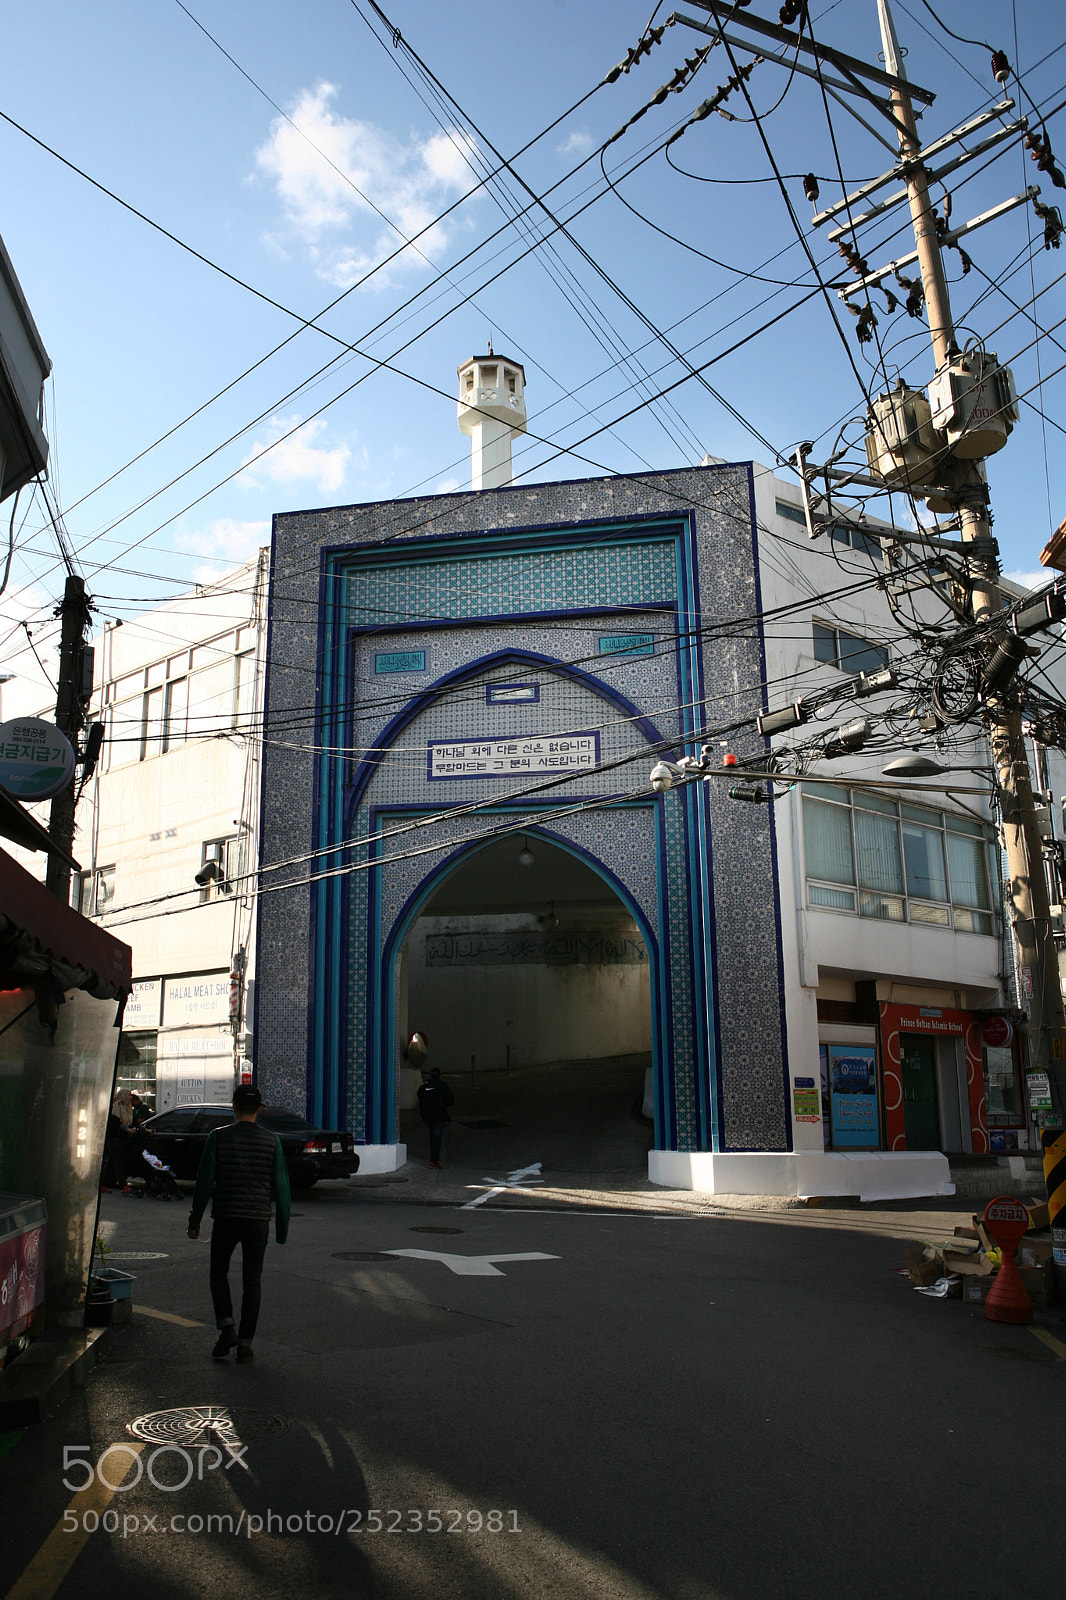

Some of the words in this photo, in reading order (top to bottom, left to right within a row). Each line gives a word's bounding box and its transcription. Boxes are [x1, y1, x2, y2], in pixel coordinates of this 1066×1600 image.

[12, 726, 47, 739] 은행공용
[436, 746, 465, 758] 하나님
[471, 746, 491, 756] 외에
[497, 745, 518, 755] 다른
[523, 743, 544, 753] 신은
[549, 740, 592, 752] 없습니다
[436, 762, 487, 773] 무함마드는
[493, 761, 504, 769] 그
[510, 758, 530, 768] 분의
[538, 755, 592, 766] 사도입니다
[169, 984, 192, 999] HALAL
[193, 984, 213, 997] MEAT
[215, 982, 230, 996] SHO
[125, 1004, 142, 1012] AMB
[900, 1017, 915, 1027] Prince
[916, 1018, 931, 1029] Sultan
[931, 1020, 948, 1030] Islamic
[948, 1021, 963, 1031] School
[991, 1208, 1023, 1220] 주차금지
